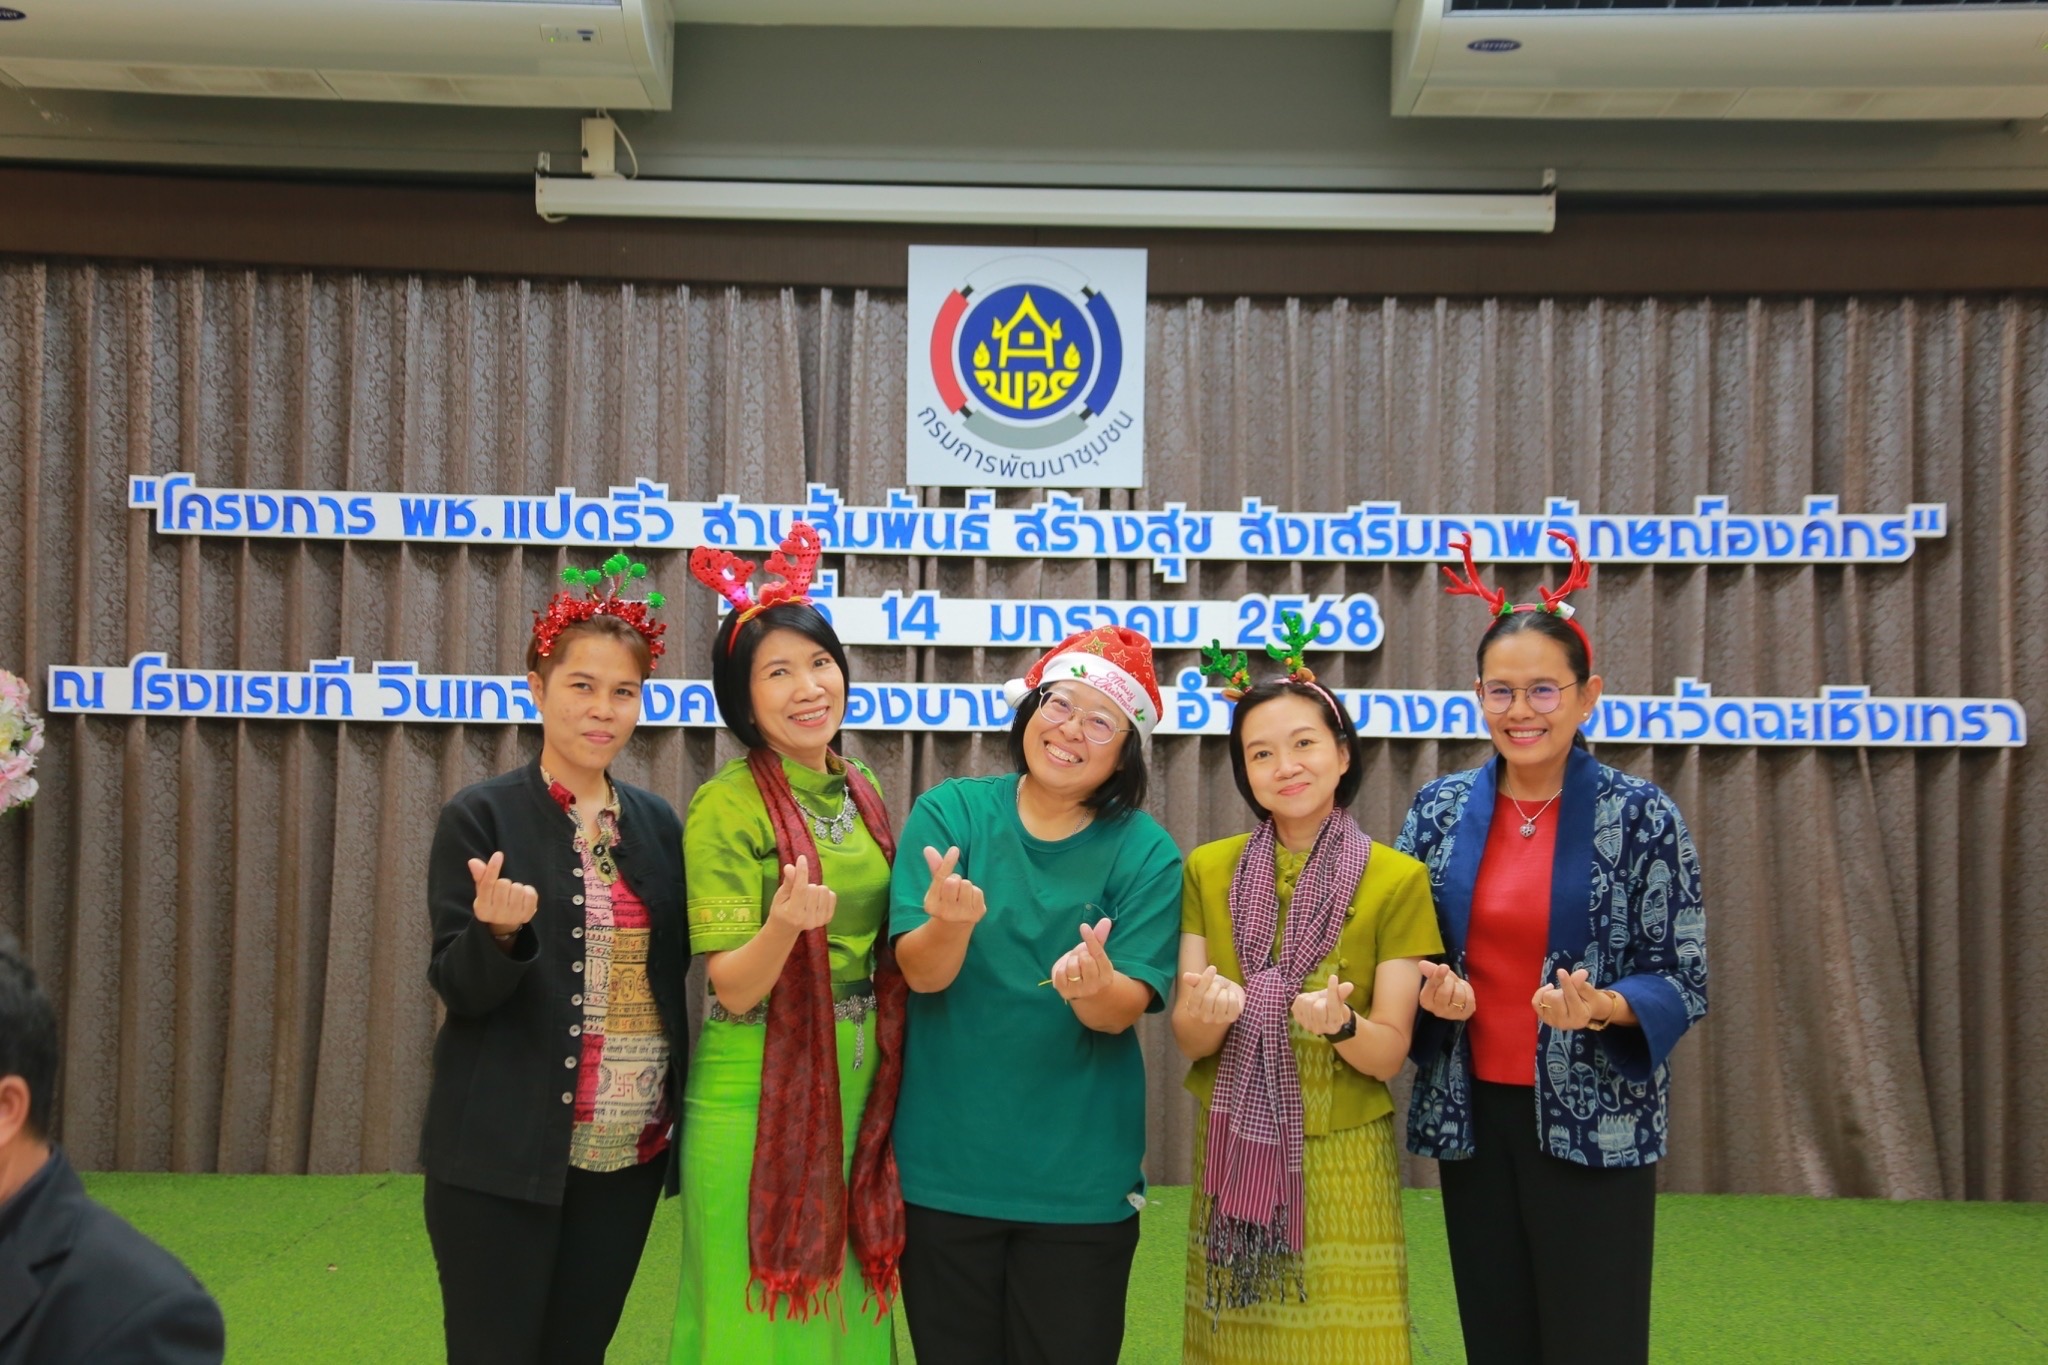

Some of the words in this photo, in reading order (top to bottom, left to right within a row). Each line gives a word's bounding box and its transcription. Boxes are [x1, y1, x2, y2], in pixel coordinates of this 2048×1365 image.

[918, 406, 1133, 479] กรมการพัฒนาชุมชน
[1014, 496, 1212, 577] สร้างสุข
[881, 595, 940, 641] 14
[1237, 599, 1378, 647] 2568
[54, 671, 104, 709] ณ
[132, 656, 353, 715] โรงแรมที
[1580, 682, 2021, 742] งหวัดฉะเชิงเทรา
